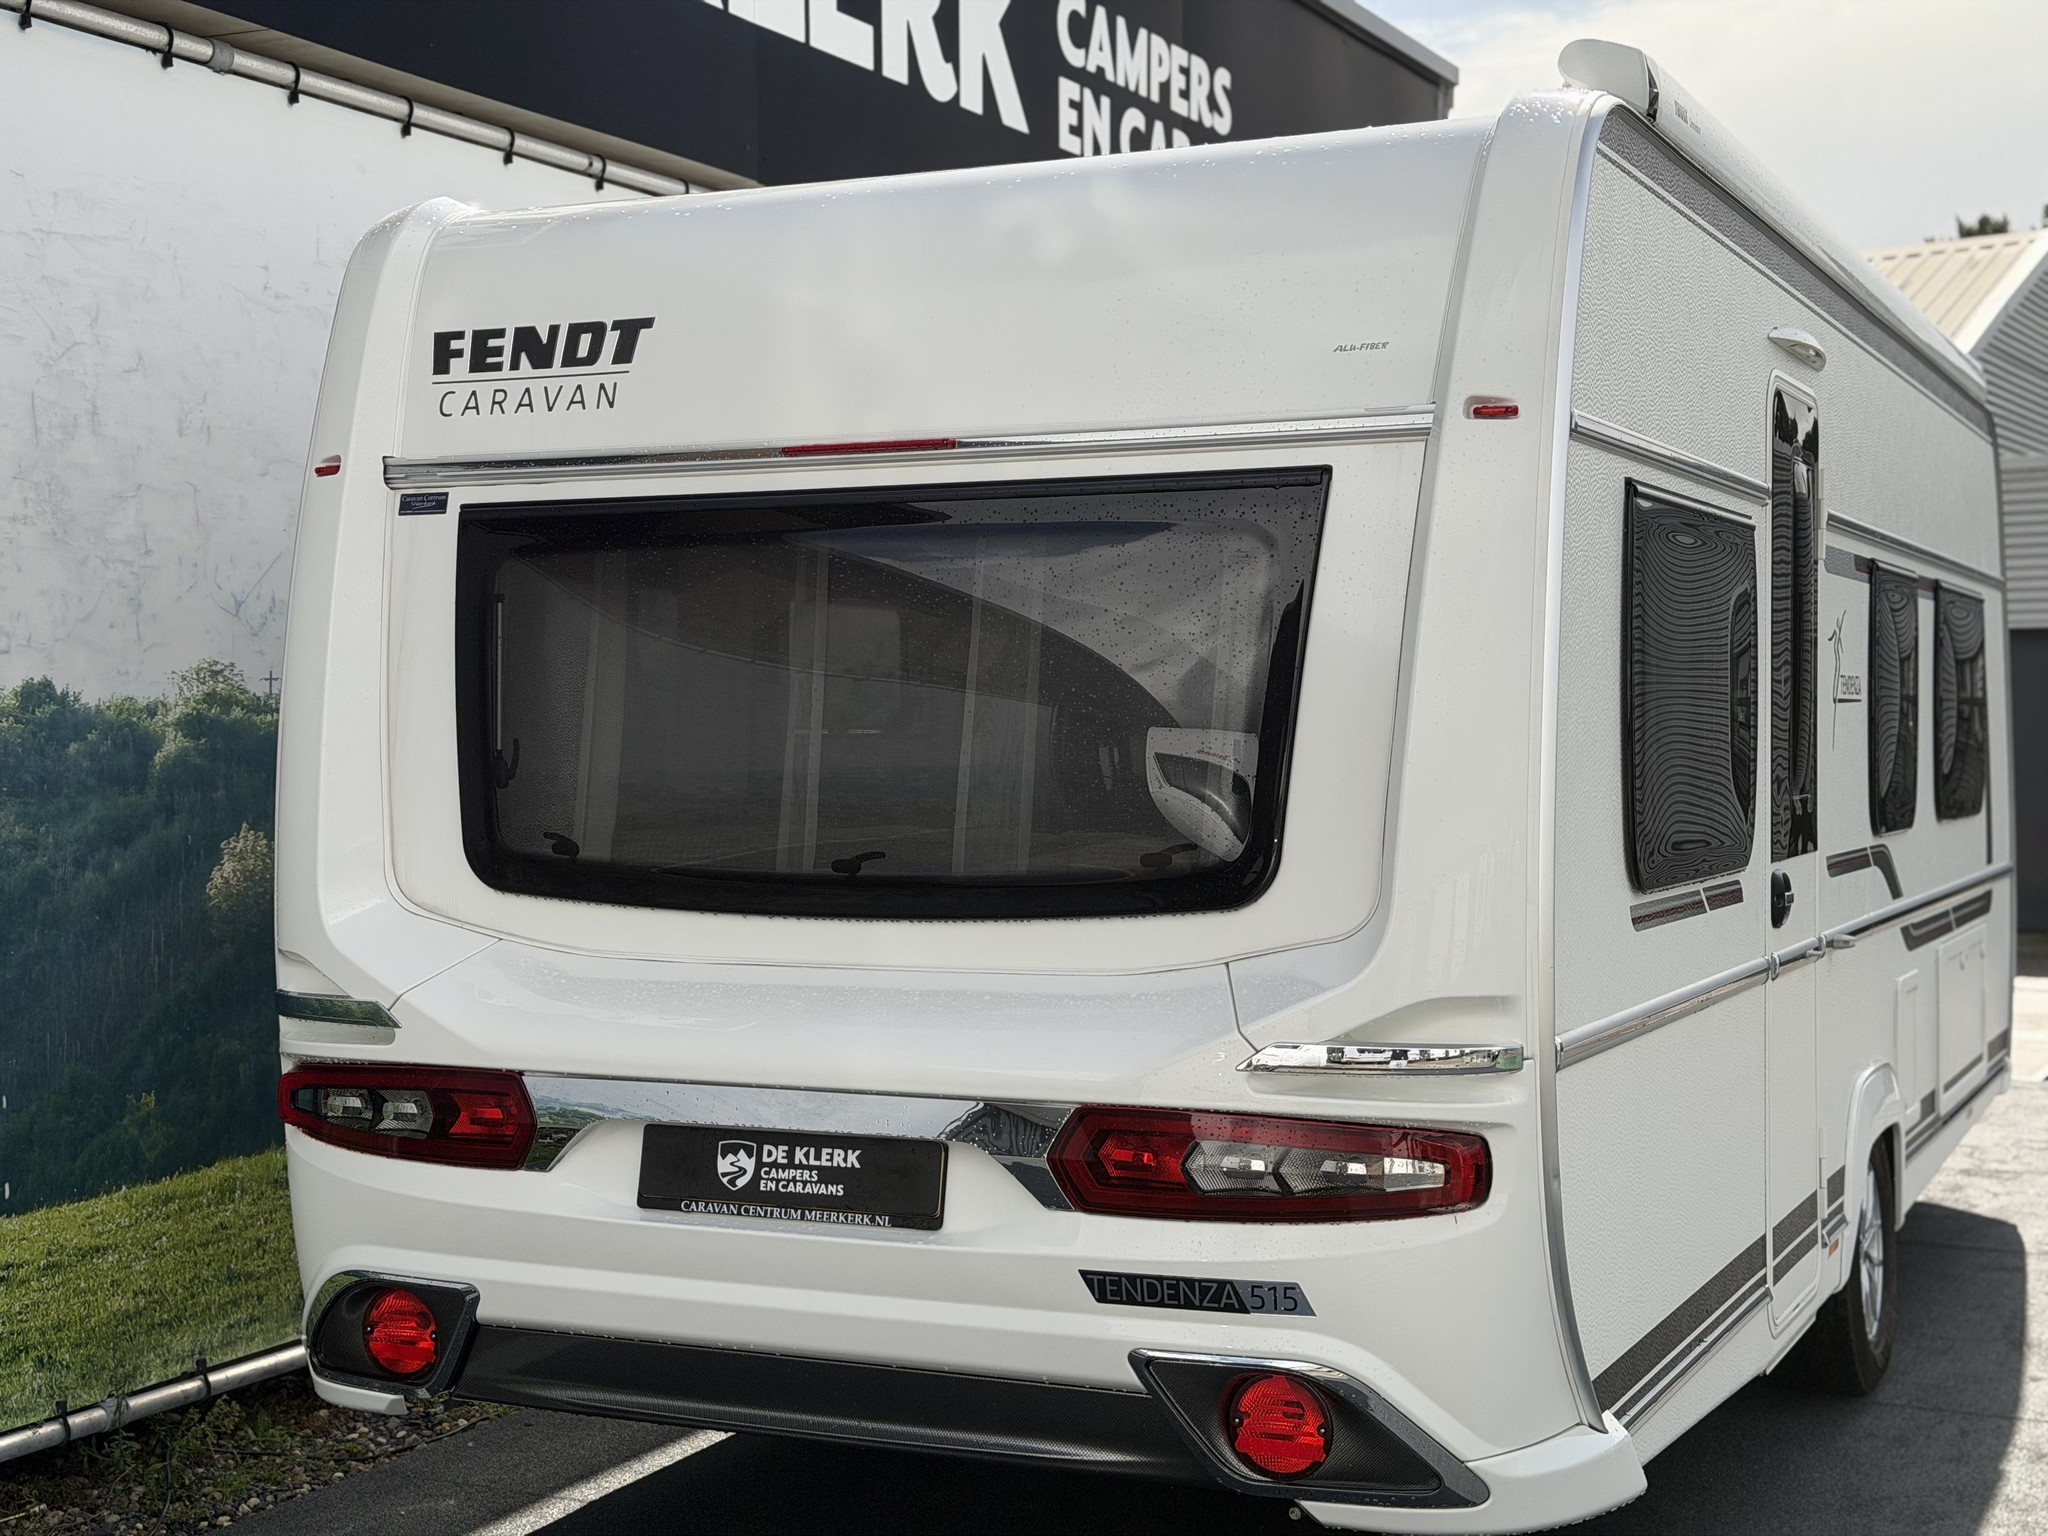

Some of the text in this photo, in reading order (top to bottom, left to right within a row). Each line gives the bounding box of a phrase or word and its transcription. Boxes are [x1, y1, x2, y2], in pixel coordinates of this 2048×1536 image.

[1057, 0, 1233, 136] CAMPERS
[1058, 76, 1111, 157] EN
[432, 316, 656, 376] FENDT
[1333, 341, 1390, 353] ALU-FIBER
[438, 382, 617, 417] CARAVAN
[762, 1144, 862, 1168] DE KLERK
[760, 1167, 819, 1181] CAMPERS
[760, 1180, 844, 1196] EN CARAVANS
[681, 1200, 892, 1227] CARAVAN CENTRUM MEERKERK.NL
[1086, 1274, 1298, 1312] TENDENZA 515
